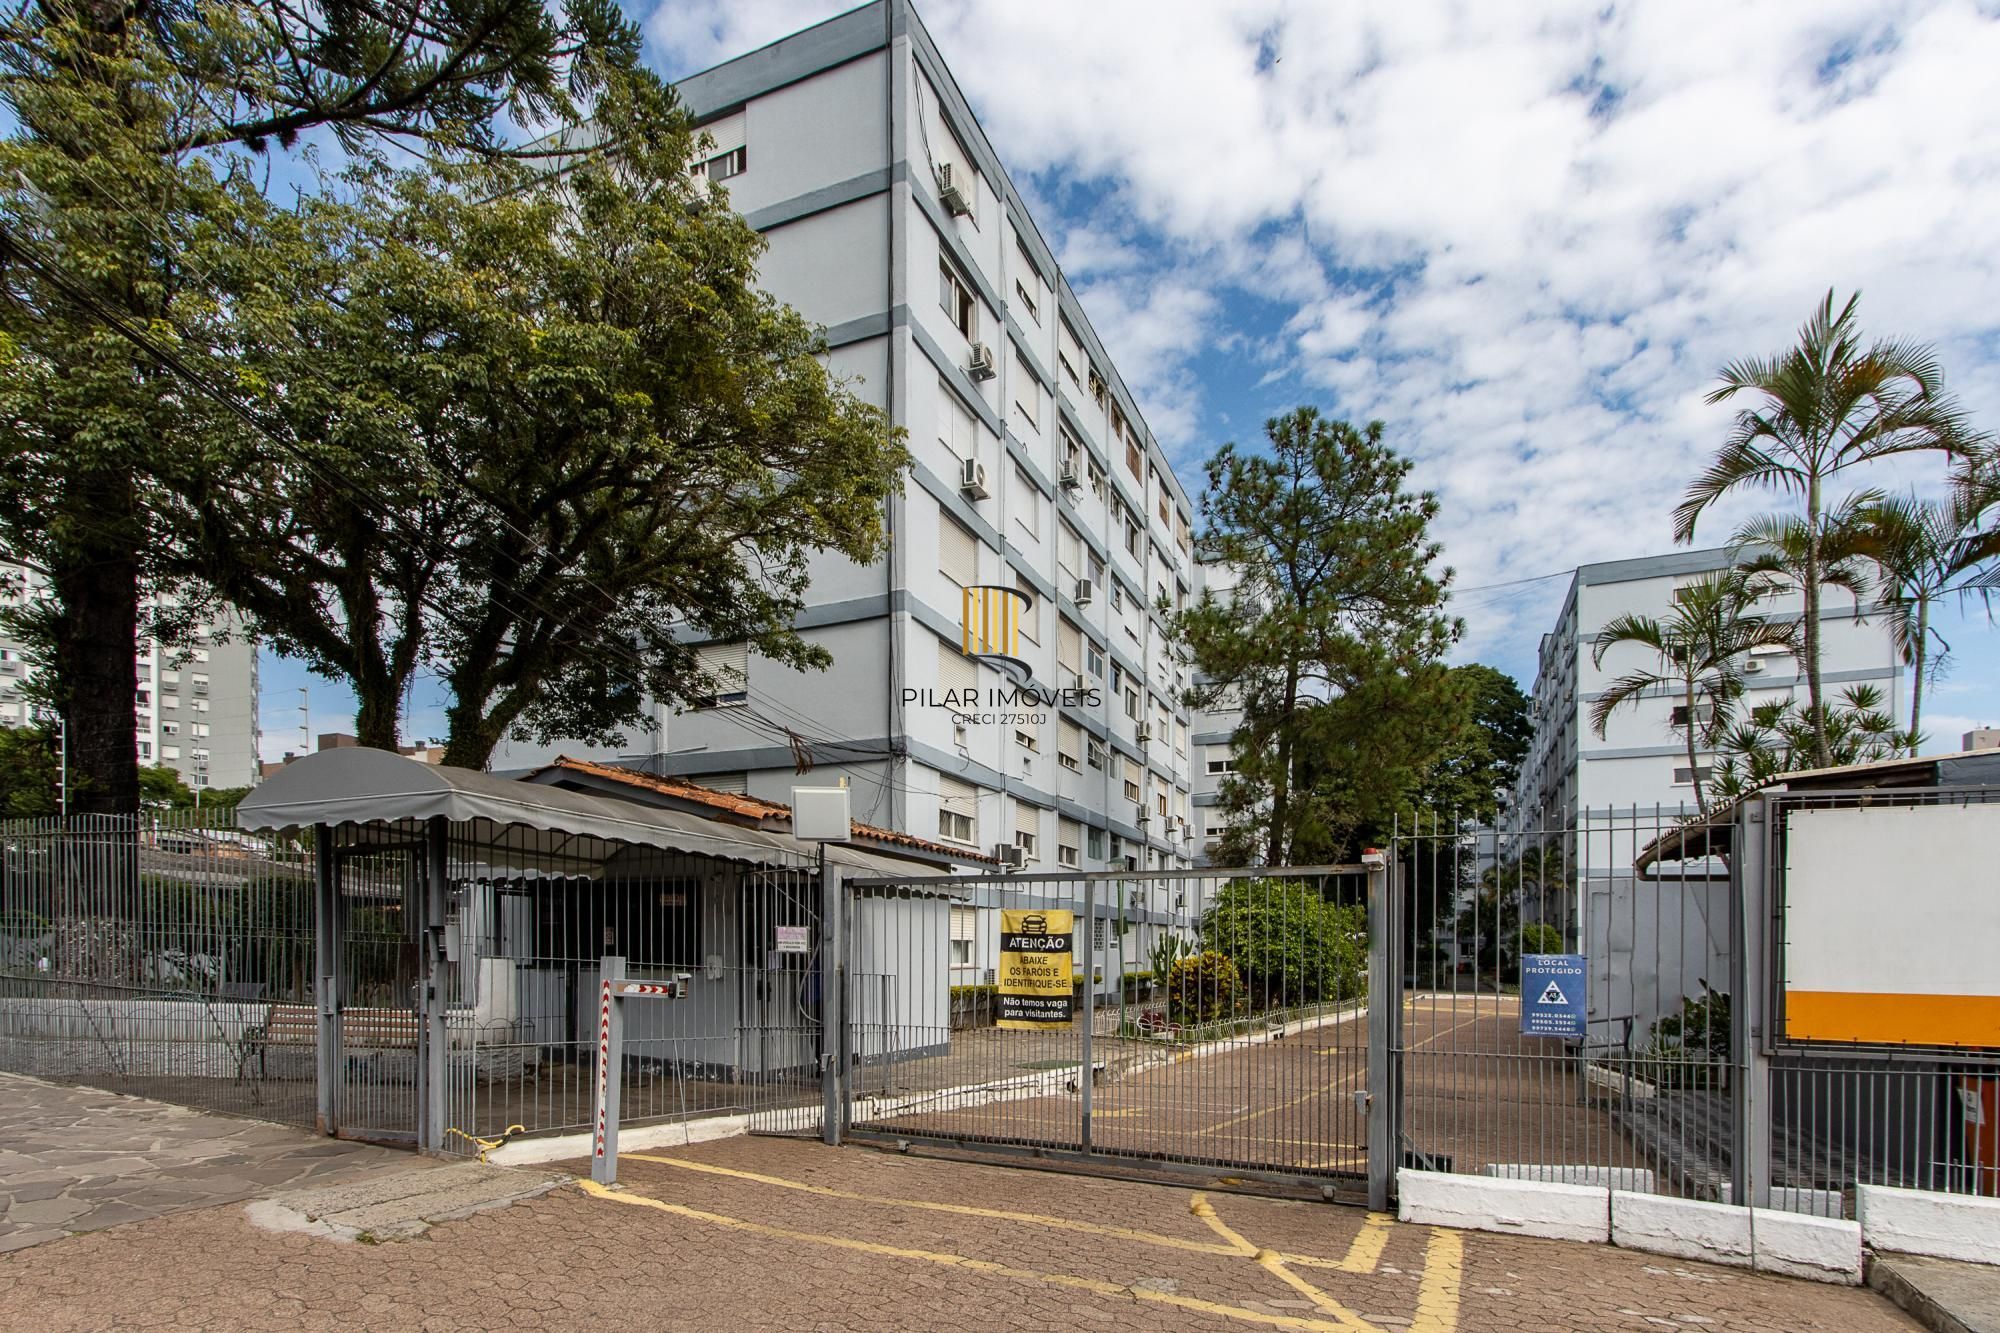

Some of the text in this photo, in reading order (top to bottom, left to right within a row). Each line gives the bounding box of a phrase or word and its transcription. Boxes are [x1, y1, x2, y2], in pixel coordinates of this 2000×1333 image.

[1009, 936, 1065, 950] ATENÇÃO
[1020, 956, 1048, 965] ABAIXE
[1010, 966, 1059, 977] OS FARÓIS E
[1003, 997, 1068, 1009] Não temos vaga
[1004, 1009, 1066, 1018] para visitantes.
